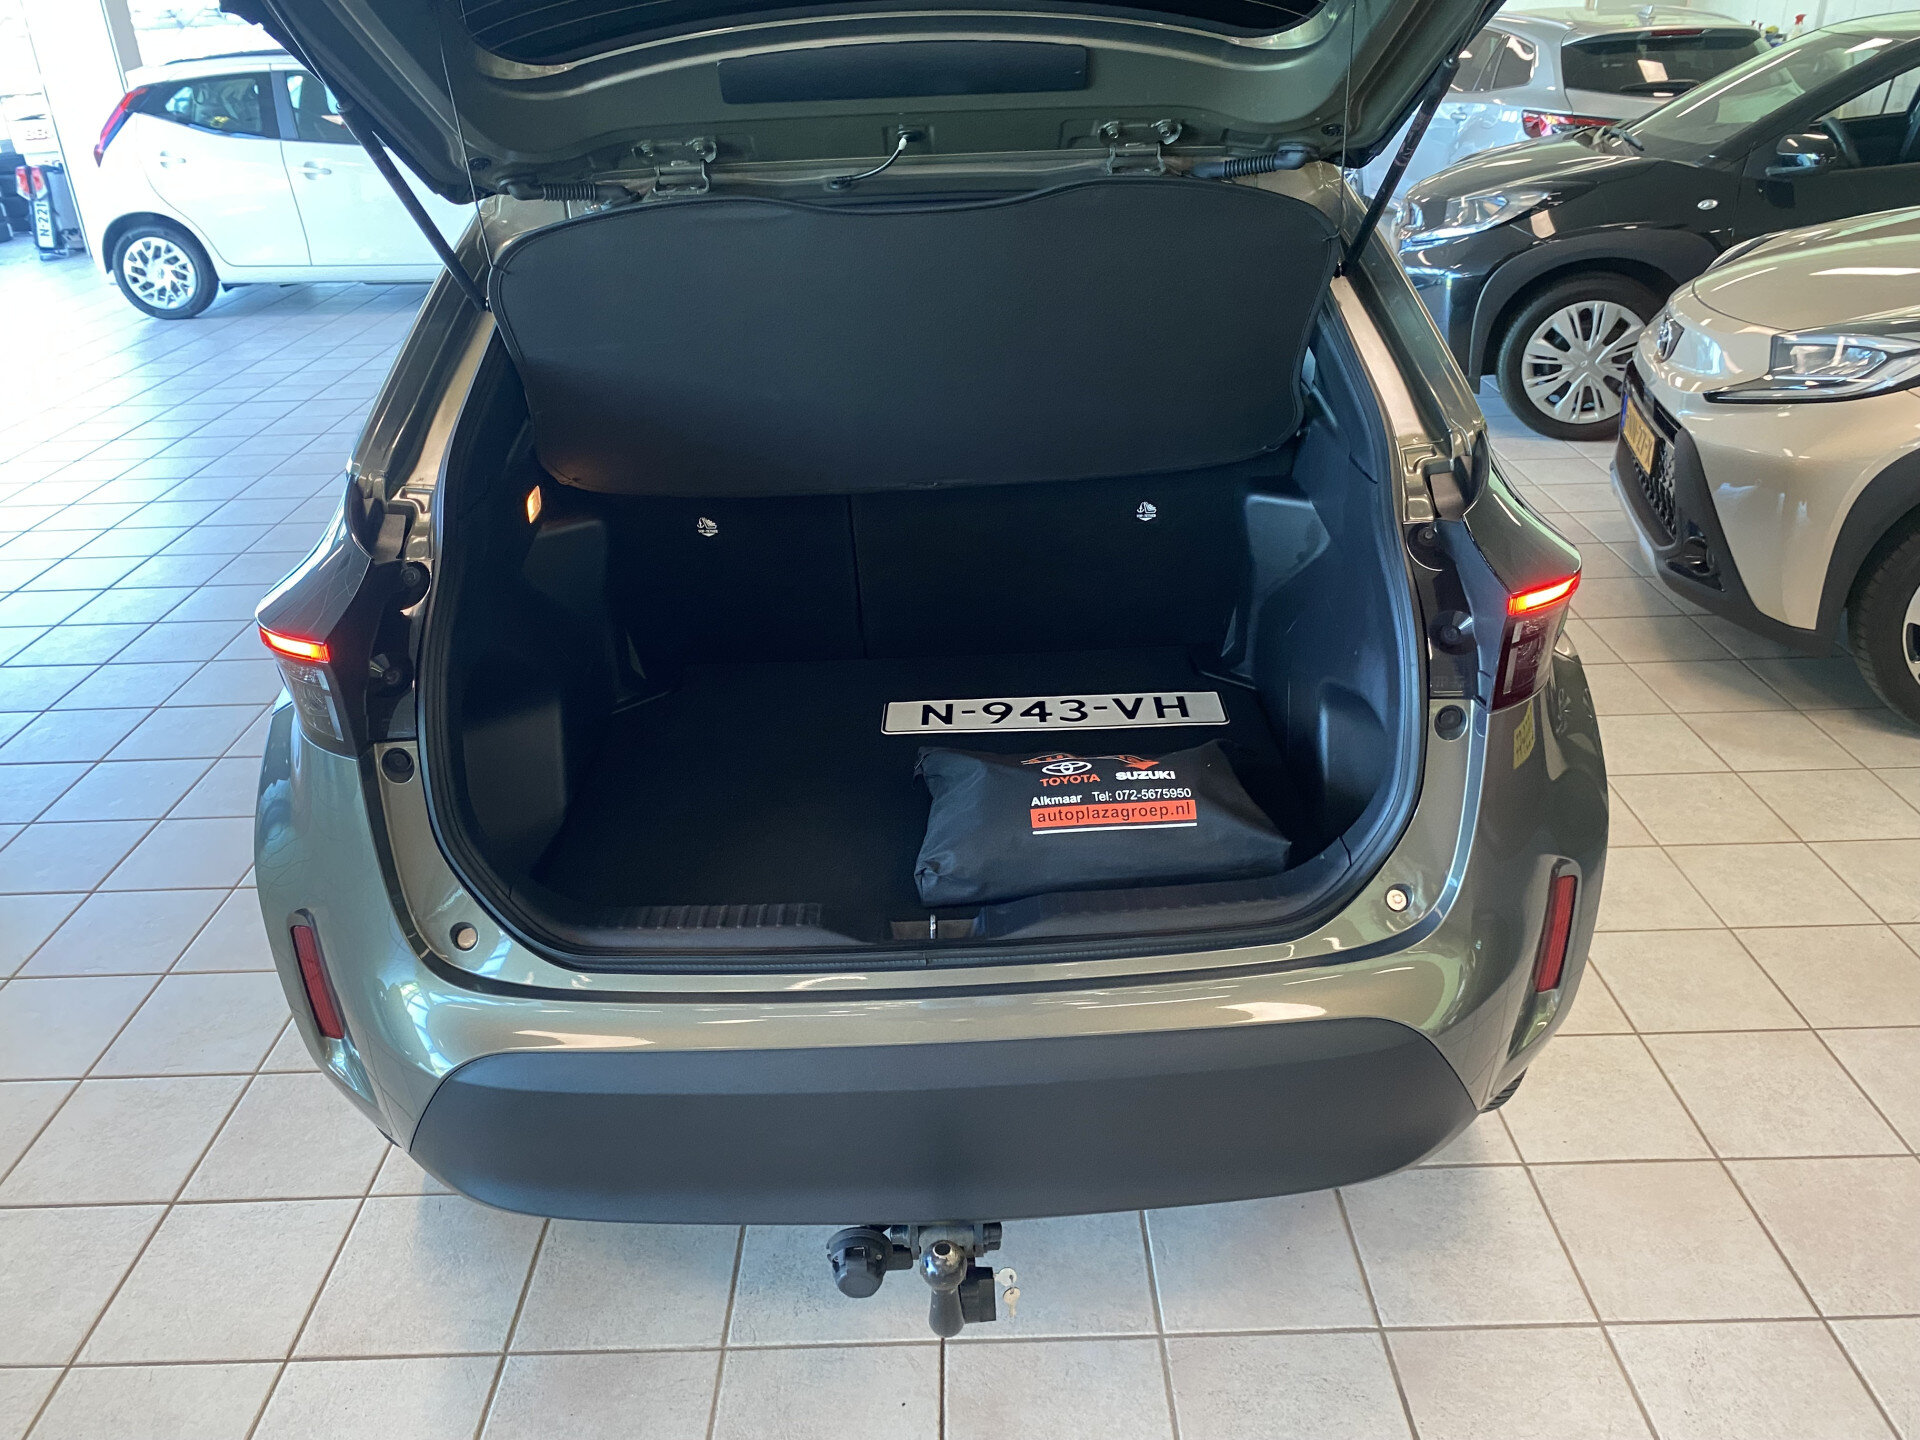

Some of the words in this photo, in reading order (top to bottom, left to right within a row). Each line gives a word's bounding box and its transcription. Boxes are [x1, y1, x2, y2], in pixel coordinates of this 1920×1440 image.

[921, 696, 1190, 726] N-943-VH
[1040, 774, 1100, 787] TOYOTA
[1115, 770, 1176, 781] SUZUKI
[1031, 795, 1082, 807] Alkmaar
[1092, 791, 1112, 802] Tel:
[1115, 788, 1191, 801] 072-5675950
[1037, 801, 1190, 823] autoplazagroep.nl
